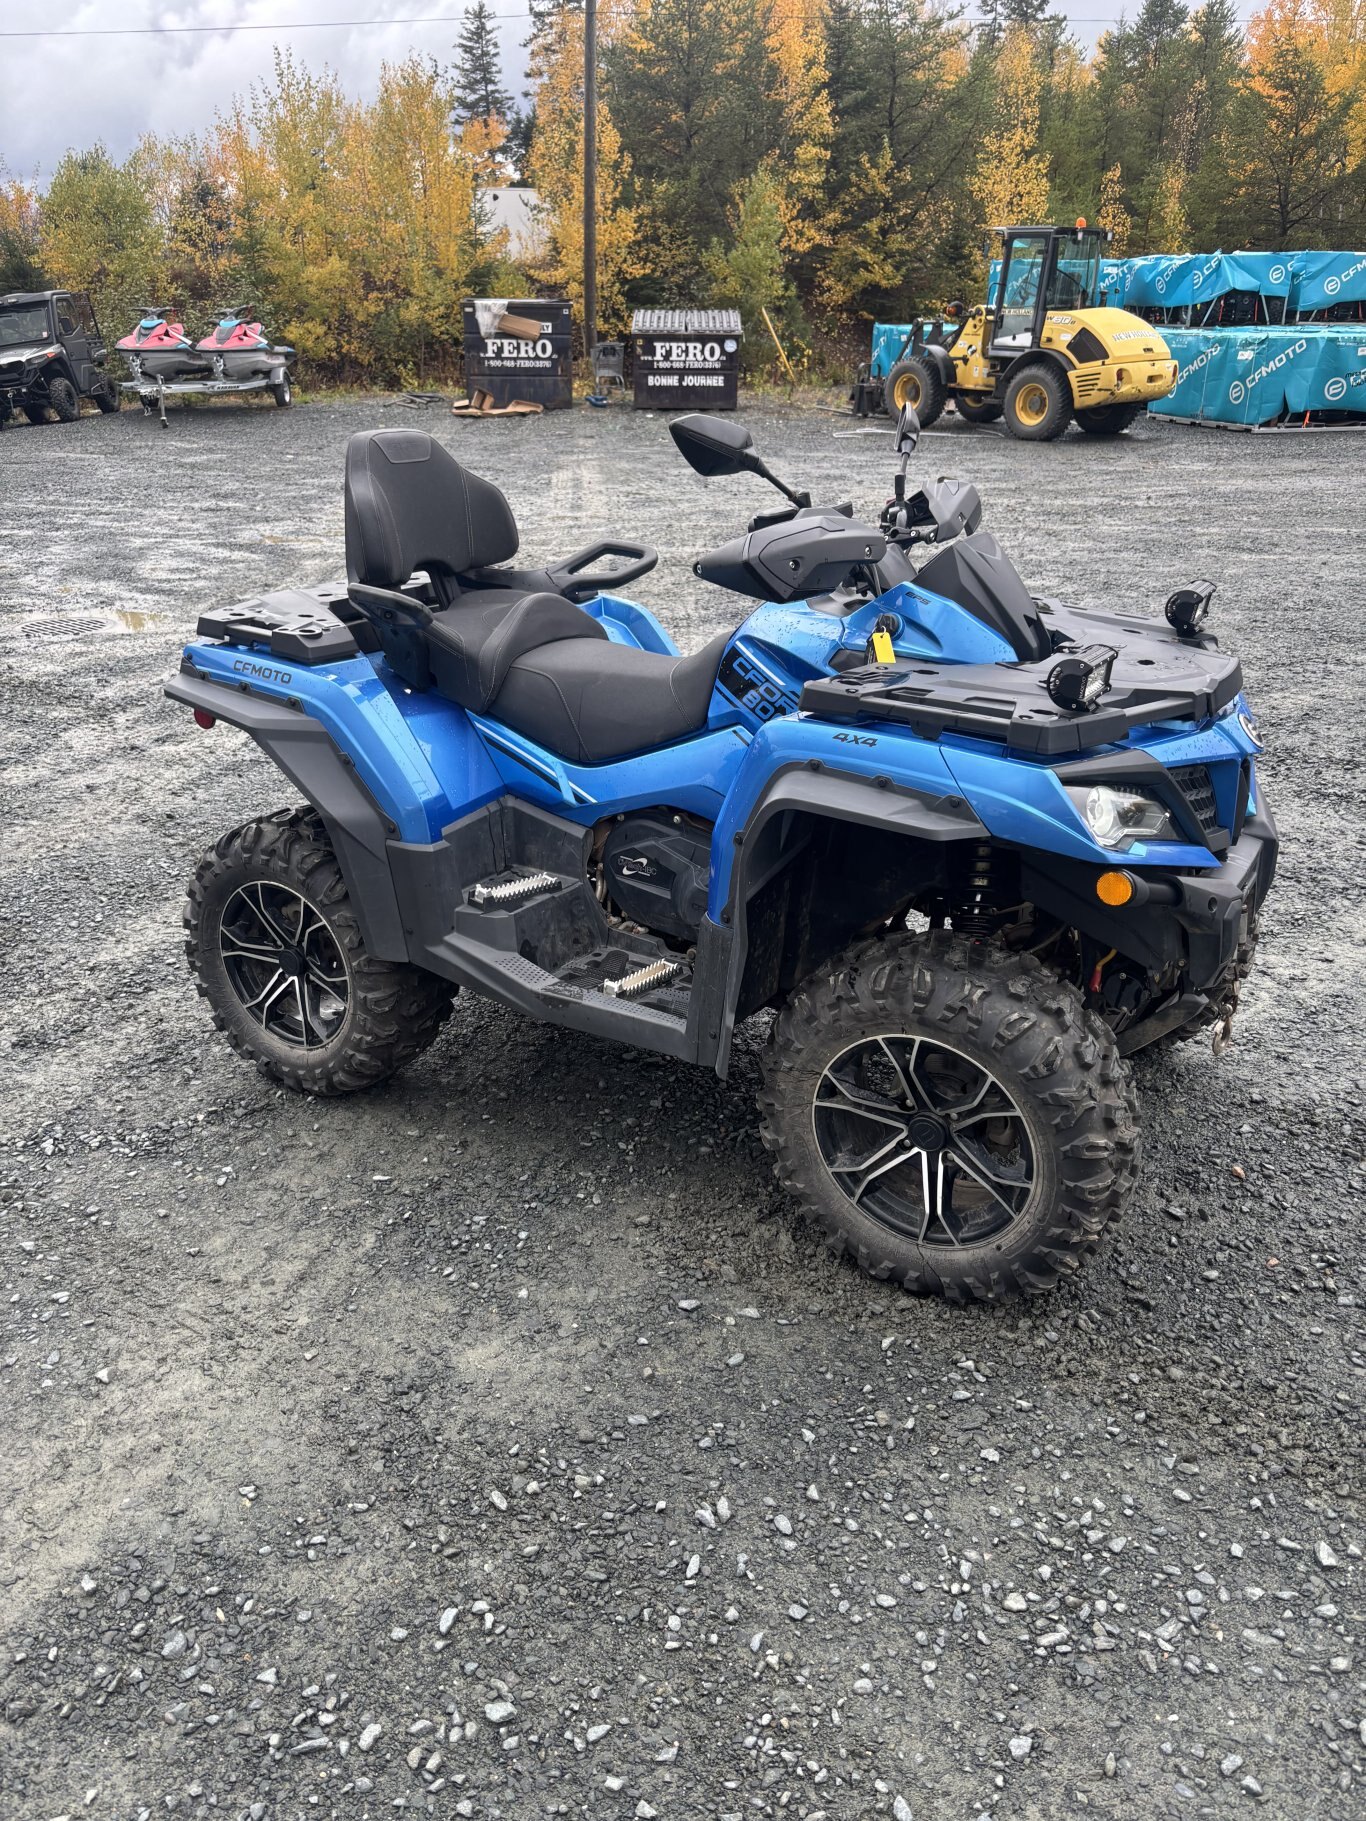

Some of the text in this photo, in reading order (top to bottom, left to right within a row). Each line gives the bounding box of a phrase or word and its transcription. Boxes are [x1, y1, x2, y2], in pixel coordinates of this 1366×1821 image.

[1177, 342, 1221, 385] CFMOTO
[1245, 338, 1308, 389] CFMOTO
[647, 375, 680, 387] BONNE
[233, 659, 293, 685] CFMOTO
